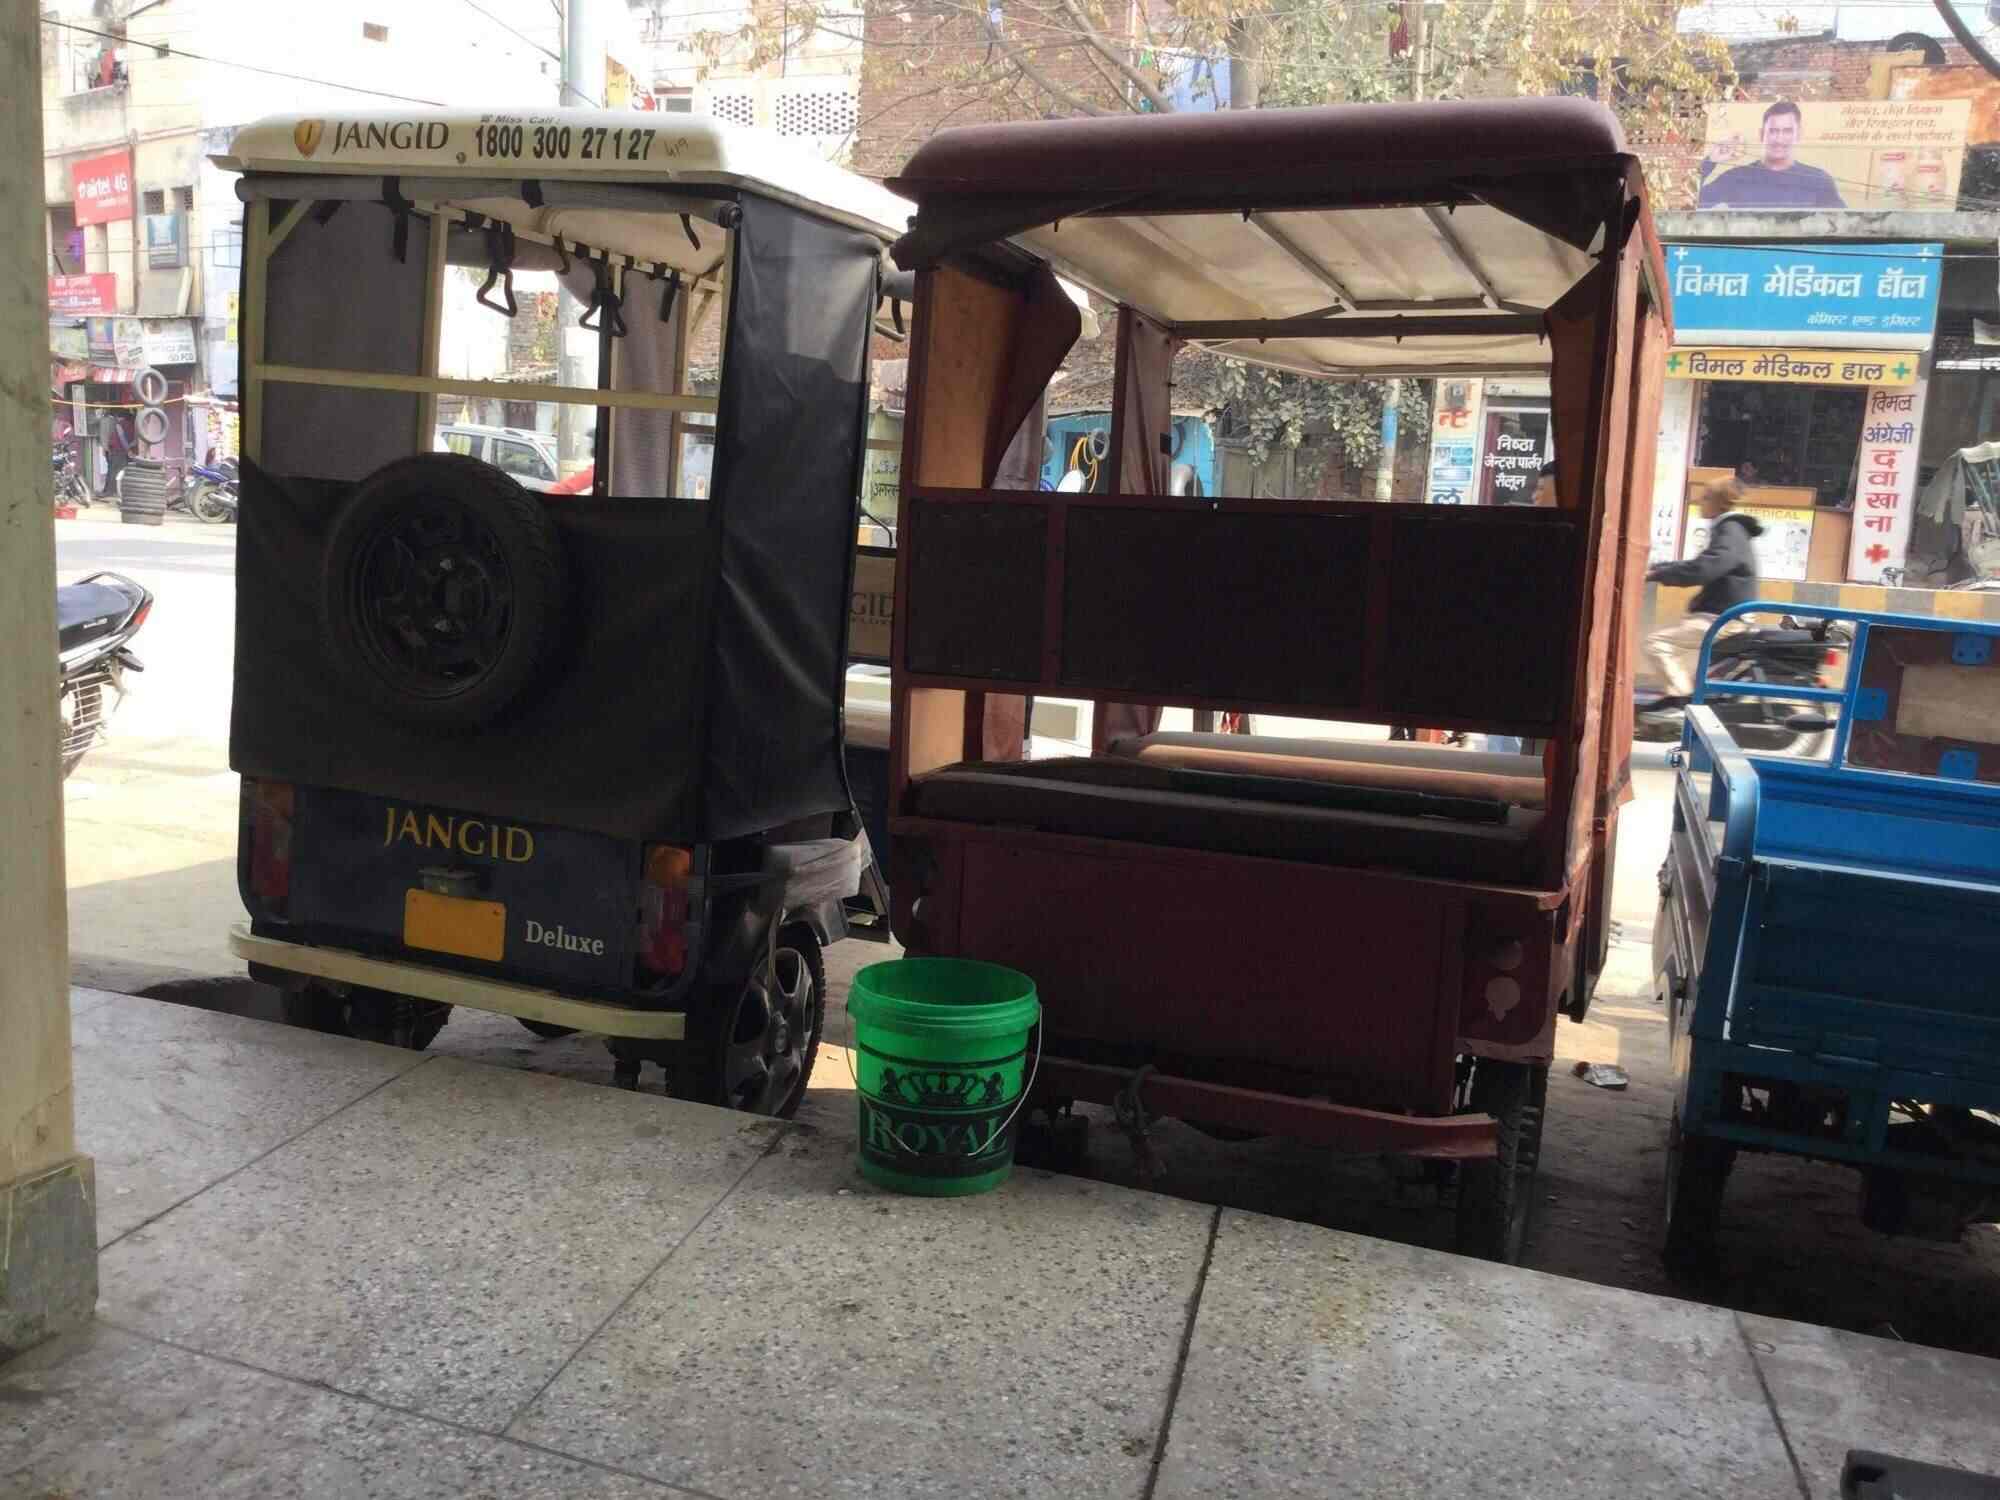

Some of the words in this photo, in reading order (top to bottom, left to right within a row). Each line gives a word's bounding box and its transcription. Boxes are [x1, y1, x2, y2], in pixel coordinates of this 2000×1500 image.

[496, 113, 523, 123] Miss
[529, 114, 554, 124] Call
[332, 121, 449, 155] JANGID
[475, 124, 523, 158] 1800
[532, 126, 571, 159] 300
[1674, 264, 1749, 297] विमल
[1764, 263, 1863, 298] मेडिकल
[1688, 352, 1747, 376] विमल
[1753, 353, 1834, 379] मेडिकल
[1841, 362, 1887, 381] हाल
[1871, 391, 1918, 415] विमल
[1496, 434, 1537, 452] निष्ठा
[1863, 422, 1915, 445] अंग्रेजी
[384, 807, 535, 864] JANGID
[525, 920, 605, 956] Deluxe
[864, 1109, 1008, 1153] ROYAL
